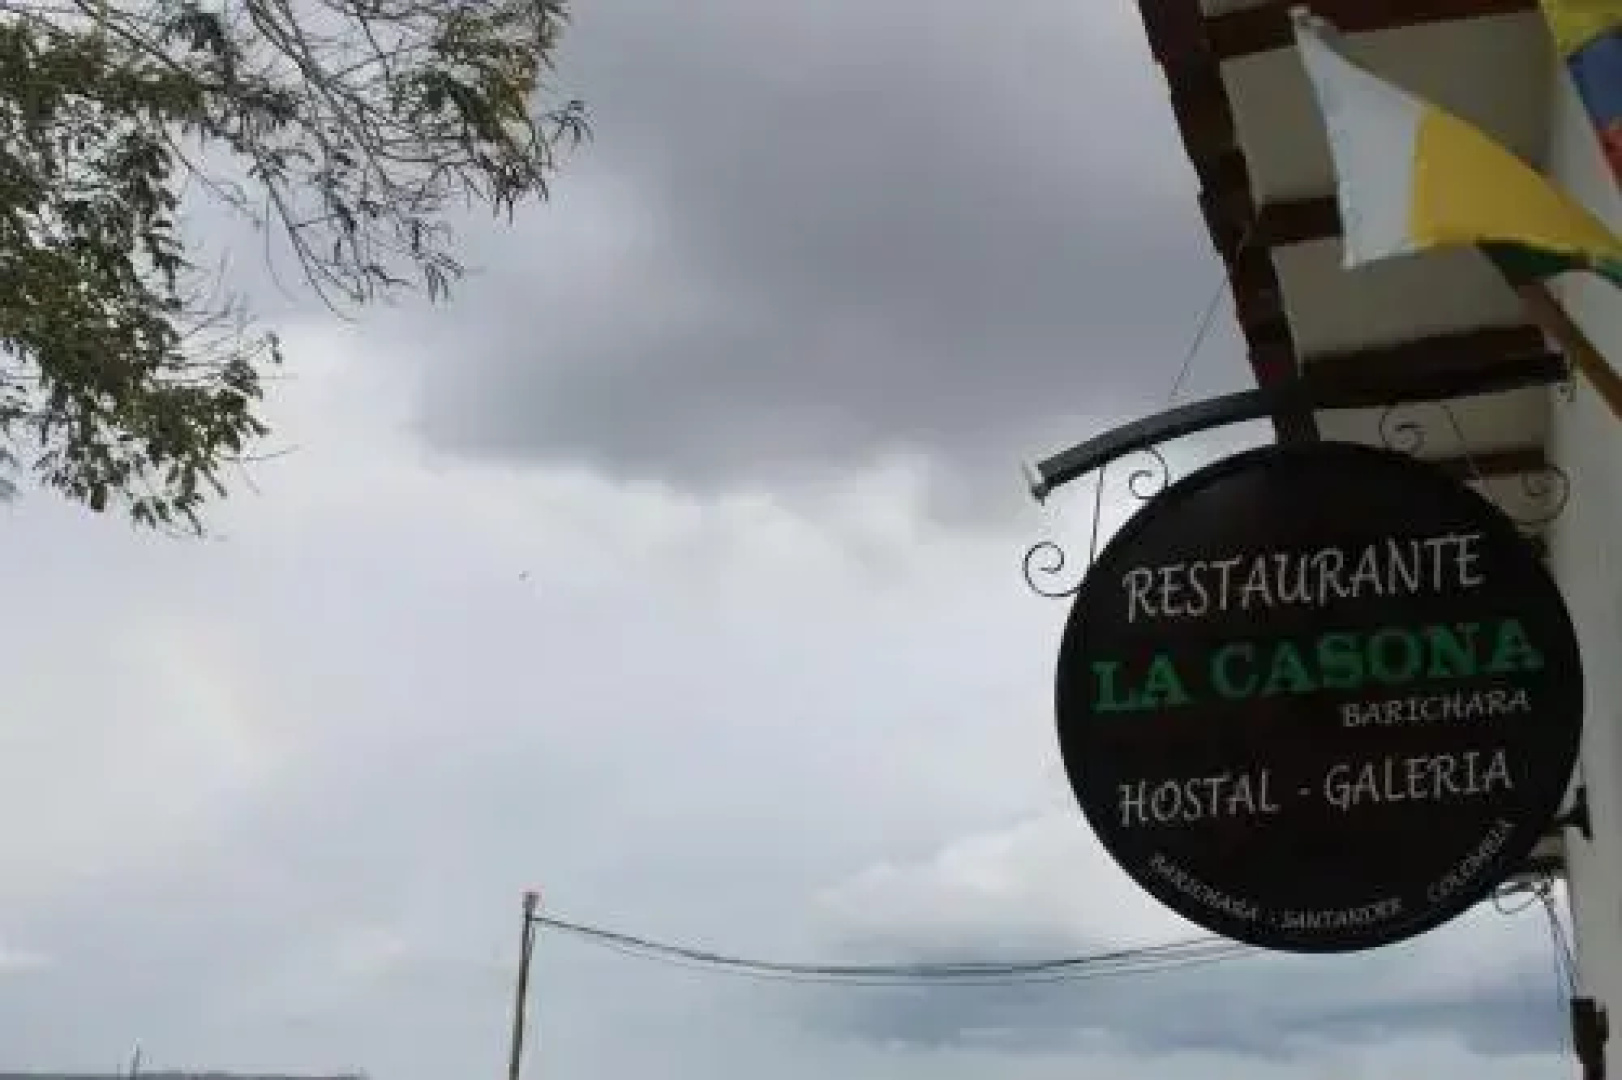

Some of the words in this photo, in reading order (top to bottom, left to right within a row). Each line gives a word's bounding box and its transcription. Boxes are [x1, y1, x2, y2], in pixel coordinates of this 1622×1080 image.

[1122, 533, 1486, 623] RESTAURANTE
[1091, 652, 1195, 713] LA
[1210, 618, 1545, 698] CASONA
[1341, 688, 1532, 728] BARICHARA
[1118, 769, 1281, 827] HOSTAL
[1323, 748, 1514, 812] GALERIA
